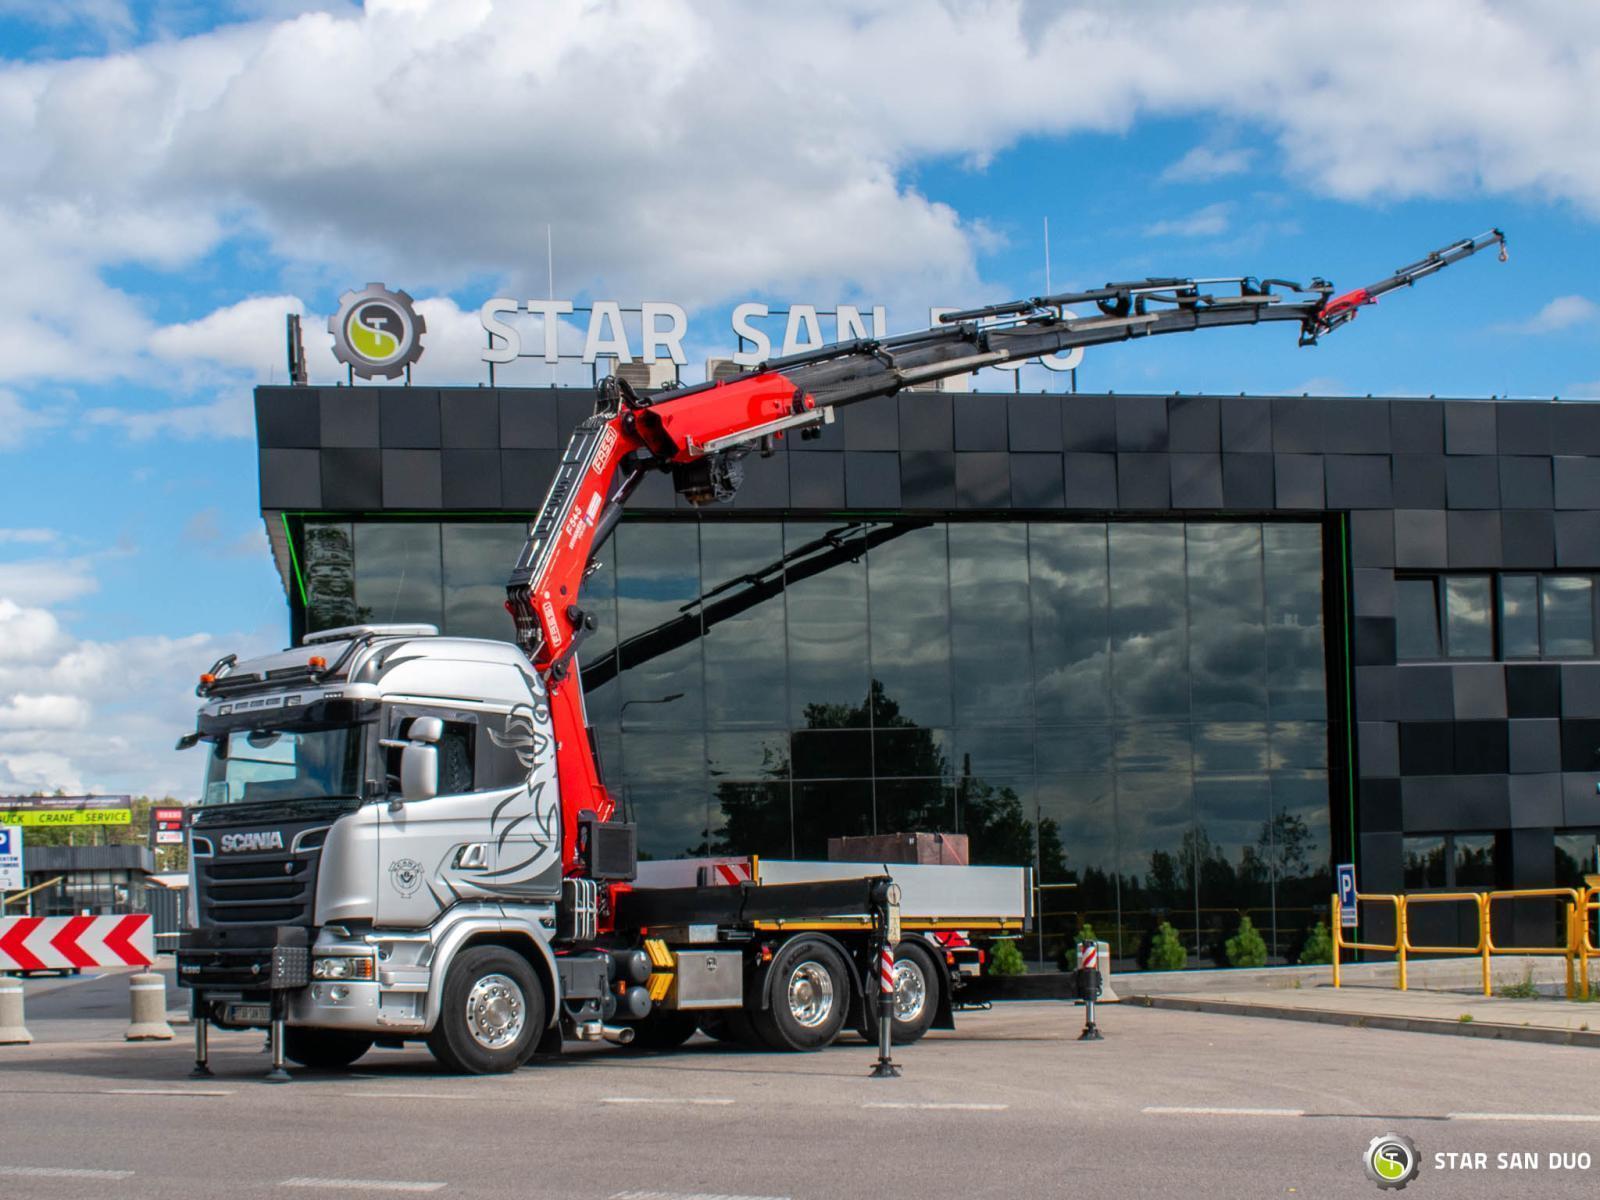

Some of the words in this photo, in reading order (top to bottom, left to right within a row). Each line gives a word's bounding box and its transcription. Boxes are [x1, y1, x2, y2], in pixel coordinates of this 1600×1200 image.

[480, 297, 689, 366] STAR
[731, 302, 887, 367] SAN
[593, 425, 617, 474] FASSI
[0, 814, 24, 824] UCK
[39, 813, 75, 823] CRANE
[86, 812, 127, 822] SERVICE
[220, 831, 284, 853] SCANIA
[1342, 874, 1352, 903] P
